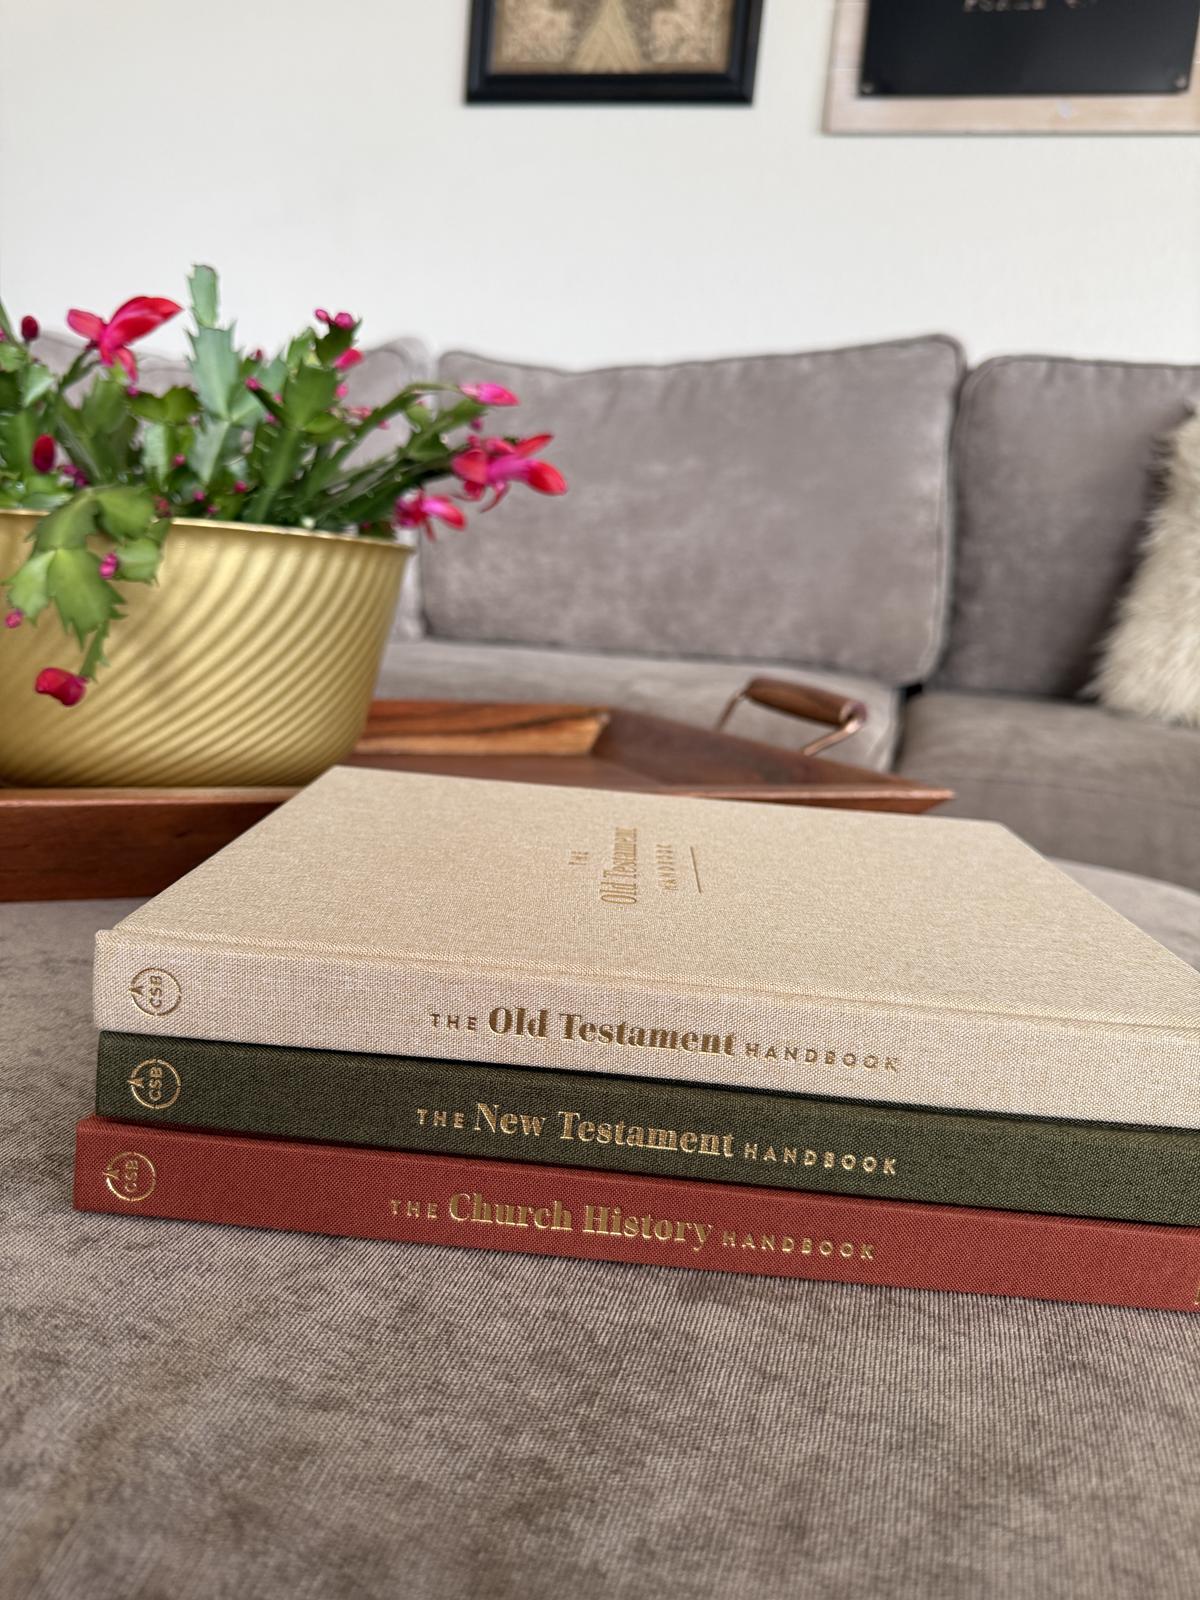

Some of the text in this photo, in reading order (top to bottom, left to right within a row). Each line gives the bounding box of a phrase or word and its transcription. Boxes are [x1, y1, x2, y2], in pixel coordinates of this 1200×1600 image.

[600, 826, 637, 905] Old Testament
[149, 975, 162, 1008] CSB
[429, 1006, 899, 1072] THE Old Testament HANDBOOK
[148, 1066, 163, 1101] CSB
[417, 1102, 897, 1175] THE New Testament HANDBOOK
[125, 1159, 139, 1193] CSB
[391, 1192, 875, 1259] THE Church History HANDBOOK
